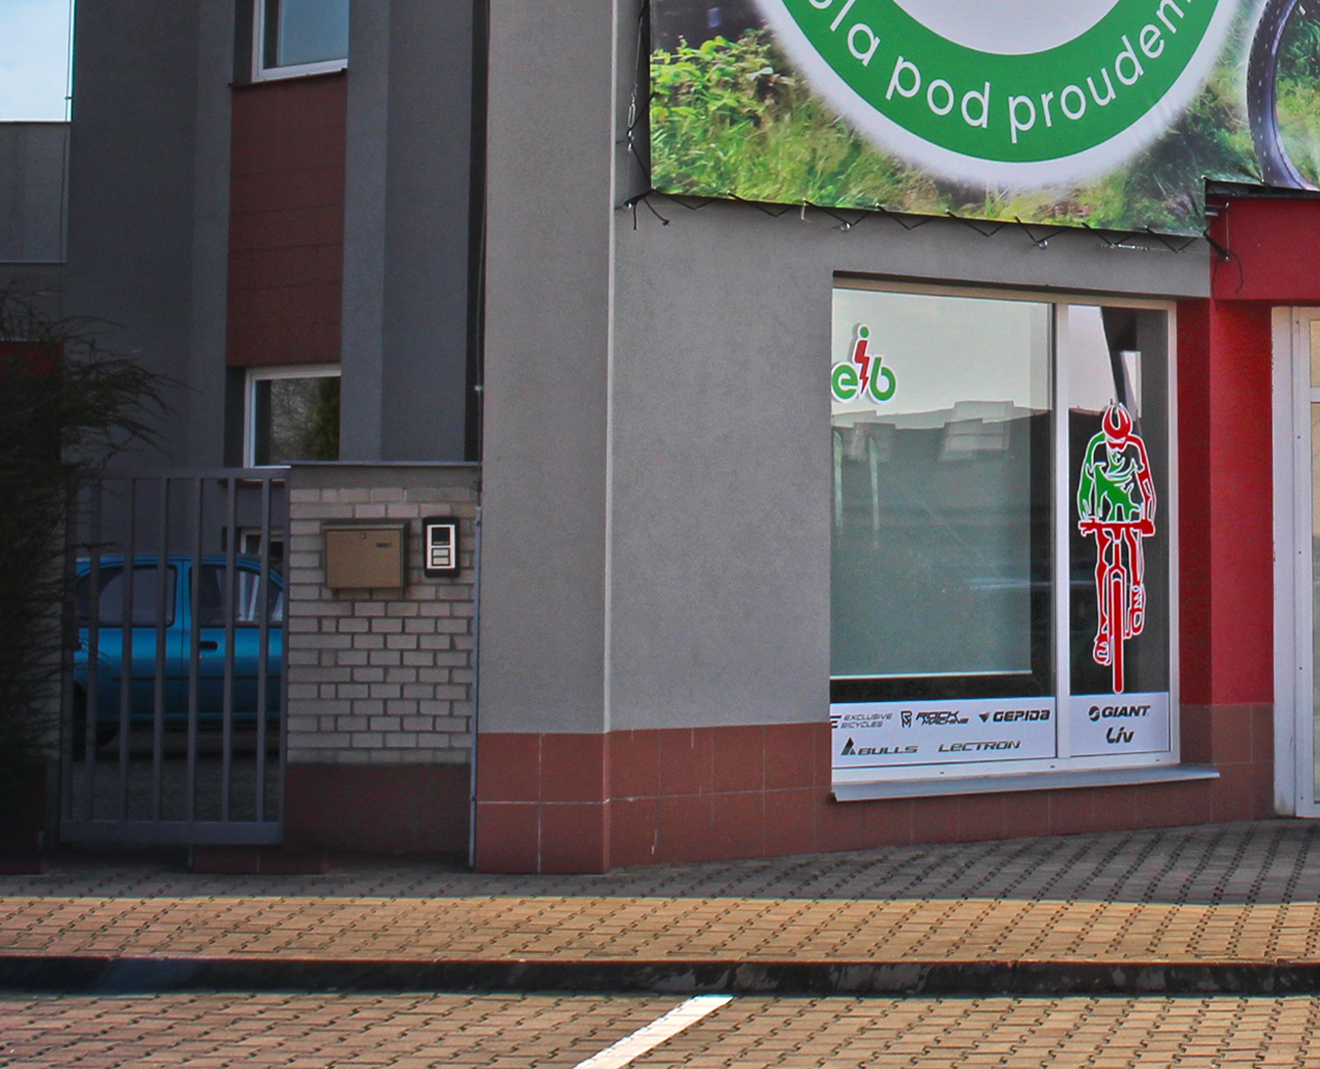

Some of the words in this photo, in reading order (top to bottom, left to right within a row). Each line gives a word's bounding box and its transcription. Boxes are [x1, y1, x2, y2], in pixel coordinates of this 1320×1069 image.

[887, 54, 991, 129] pod
[843, 712, 893, 722] EXCLUSIVE
[915, 710, 960, 721] ROCK
[1101, 705, 1151, 719] GIANT
[840, 720, 884, 729] BICYCLES
[858, 745, 919, 756] BULLS
